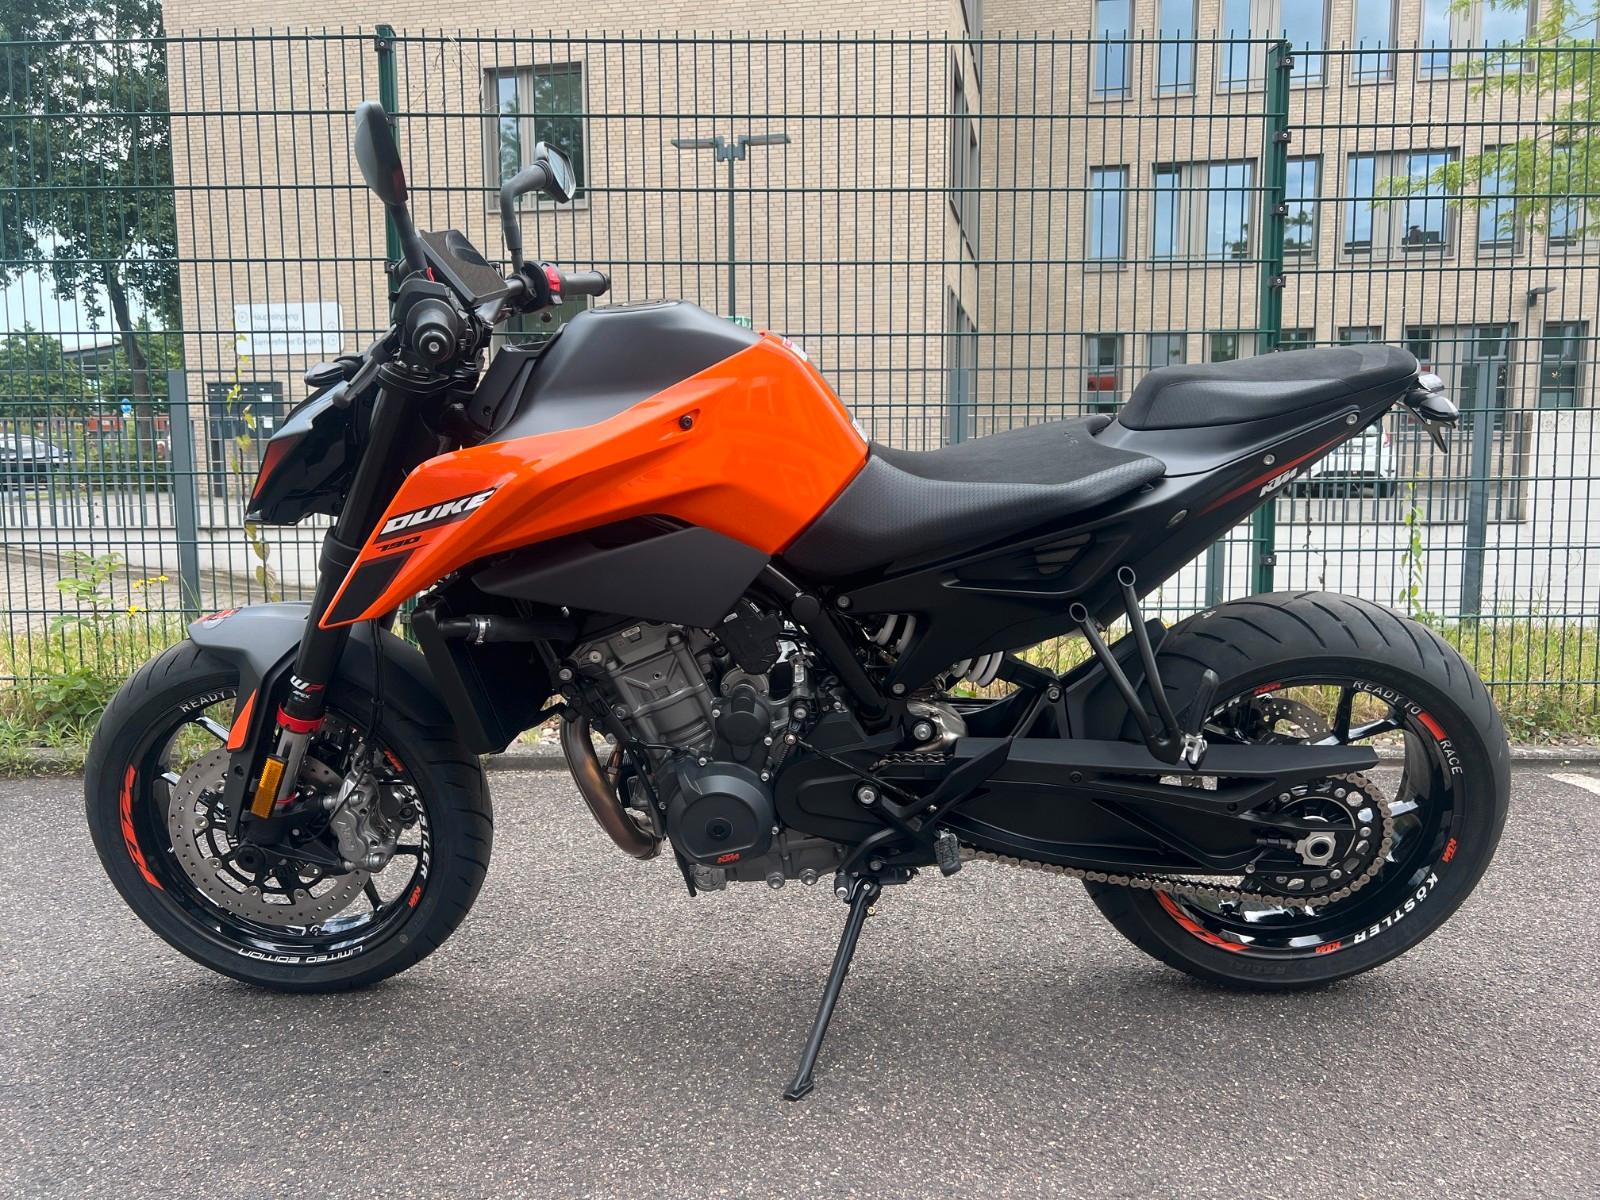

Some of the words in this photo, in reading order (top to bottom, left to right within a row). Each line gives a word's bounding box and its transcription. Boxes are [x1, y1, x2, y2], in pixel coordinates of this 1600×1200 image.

[1259, 467, 1298, 498] KTM
[380, 489, 497, 535] DUKE
[289, 675, 325, 693] WP
[180, 690, 226, 713] READY
[1352, 680, 1404, 703] READY
[1404, 702, 1422, 715] TO
[1440, 740, 1463, 775] RACE
[716, 852, 740, 865] KTM
[1441, 837, 1457, 863] KTM
[1354, 872, 1439, 944] KÖSTLER
[238, 948, 300, 963] EDITION
[305, 945, 363, 963] LIMITED
[1315, 941, 1342, 954] KTM
